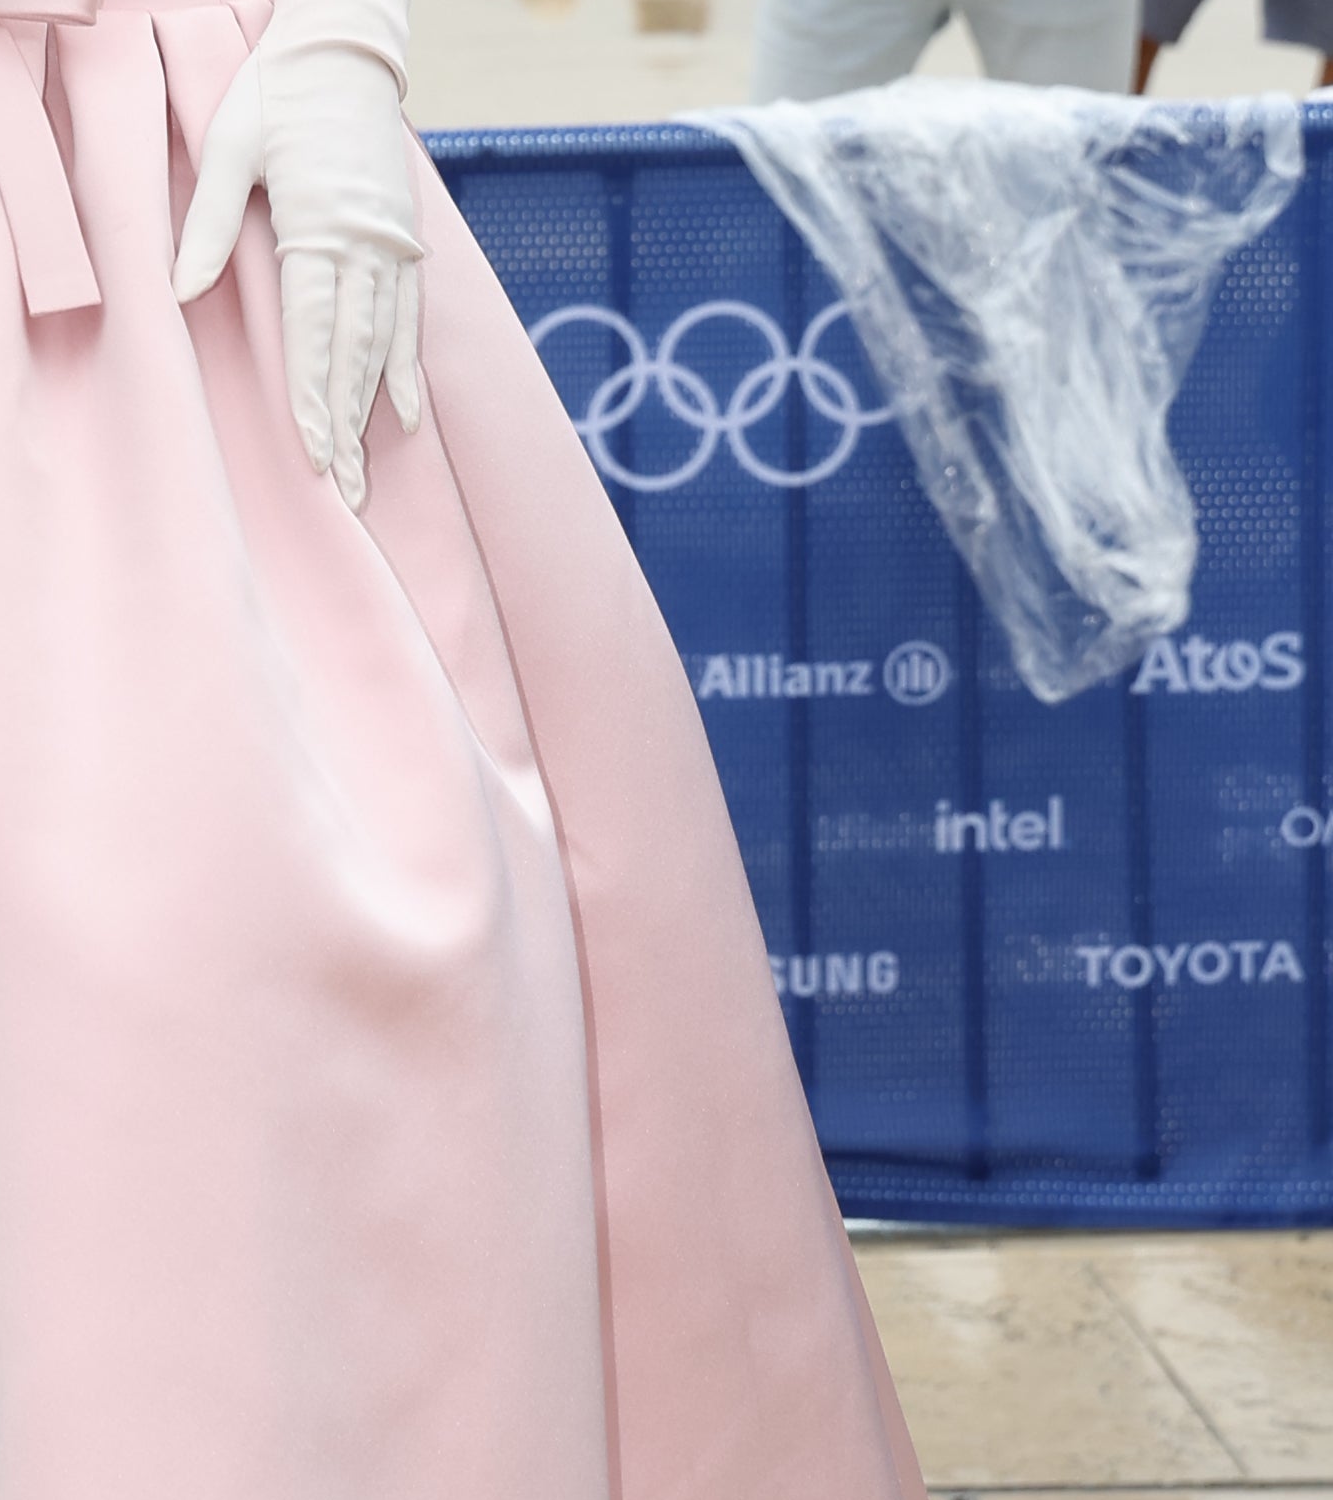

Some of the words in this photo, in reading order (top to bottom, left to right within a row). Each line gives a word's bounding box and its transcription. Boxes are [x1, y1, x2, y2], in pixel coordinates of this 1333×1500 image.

[699, 653, 874, 698] Allianz
[934, 796, 1065, 853] intel
[1280, 806, 1333, 847] O
[1075, 940, 1306, 989] TOYOTA
